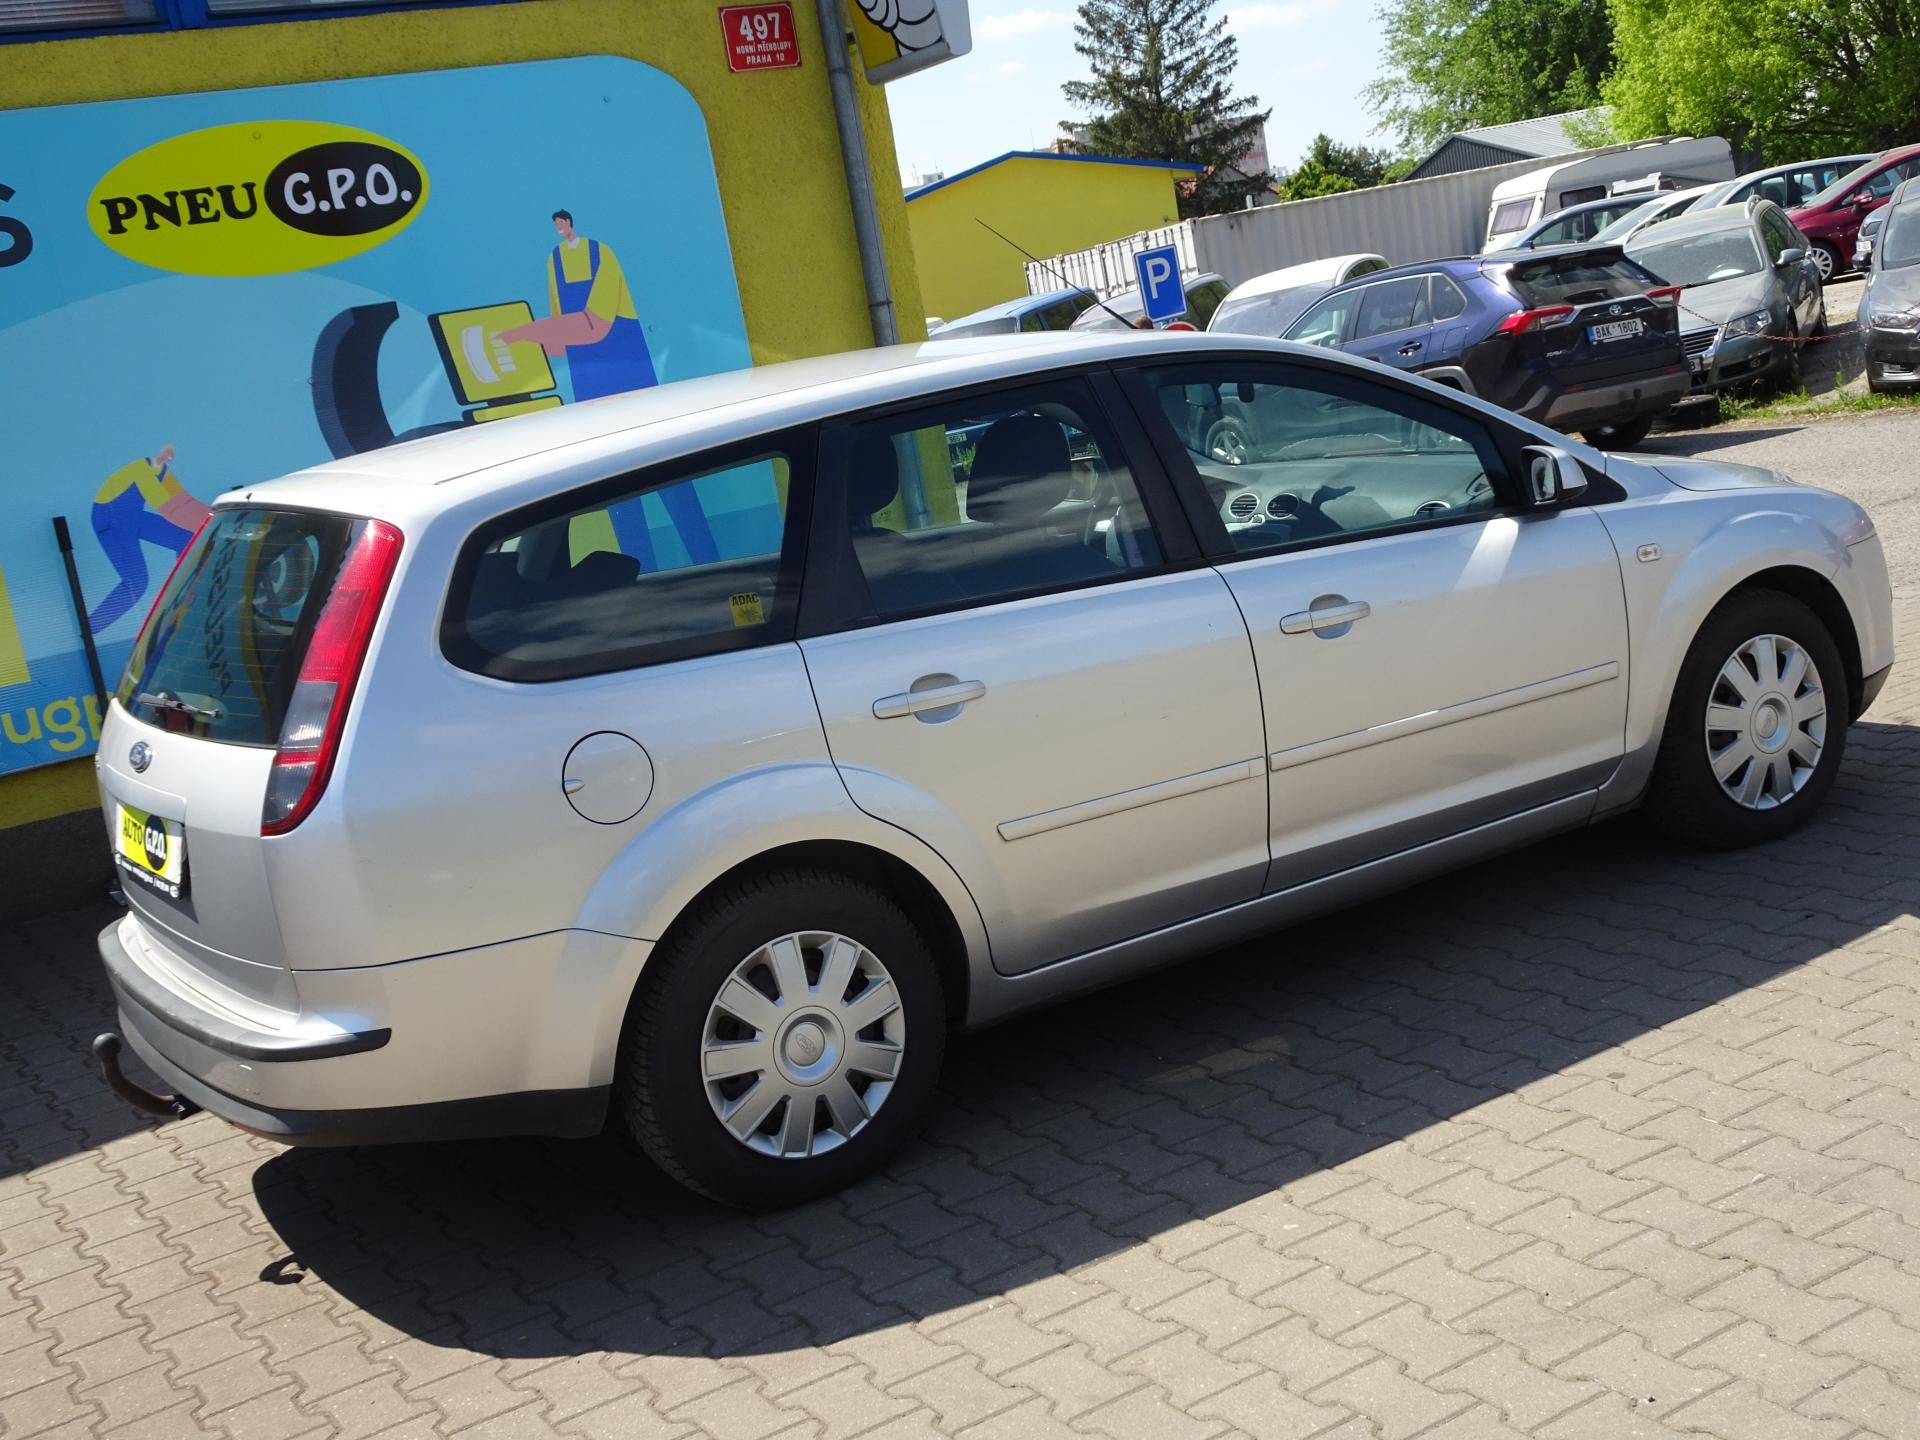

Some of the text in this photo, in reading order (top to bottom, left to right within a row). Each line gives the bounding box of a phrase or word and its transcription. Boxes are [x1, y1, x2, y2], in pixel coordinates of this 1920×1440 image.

[739, 12, 780, 41] 497
[736, 42, 756, 55] HORNÍ
[746, 53, 785, 64] PRAHA 10
[100, 163, 413, 235] PNEU G.P.O.
[1145, 257, 1171, 299] P
[732, 593, 759, 606] ADAC
[123, 816, 143, 845] AUTO
